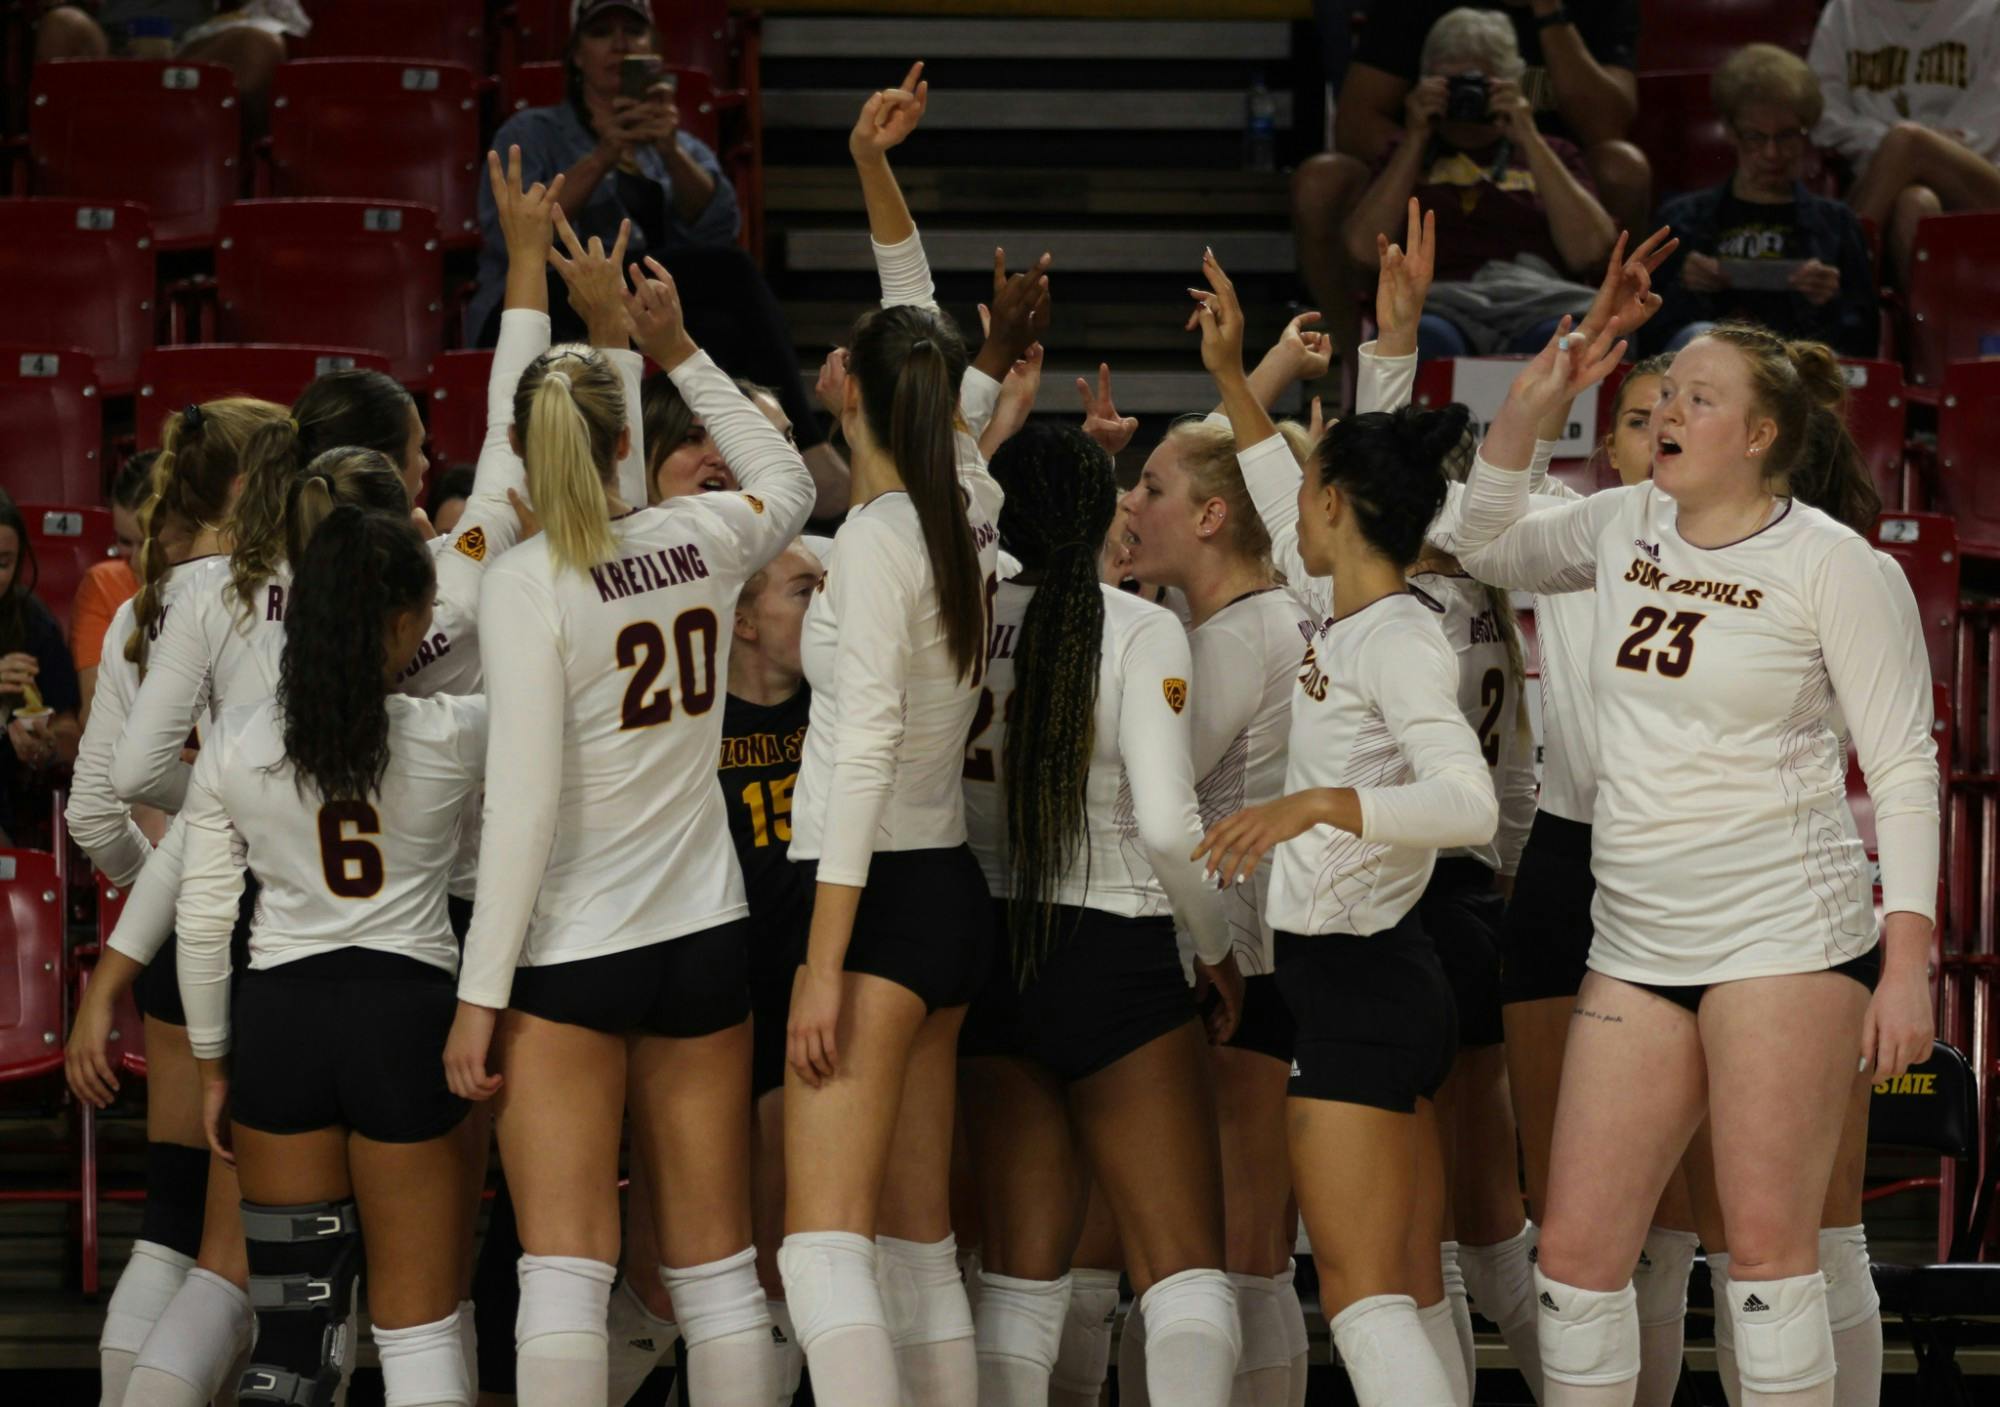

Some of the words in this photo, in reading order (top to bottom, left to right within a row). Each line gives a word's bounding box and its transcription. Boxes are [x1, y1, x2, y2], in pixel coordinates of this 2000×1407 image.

[33, 354, 45, 374] 4
[56, 516, 68, 534] 4
[1894, 521, 1906, 541] 2
[589, 543, 710, 603] KREILING
[1624, 558, 1669, 590] SUN
[1616, 606, 1707, 678] 23
[616, 607, 718, 730] 20
[718, 733, 784, 770] ZONA
[741, 772, 798, 850] 15
[318, 800, 384, 898] 6
[1874, 1073, 1938, 1096] STATE
